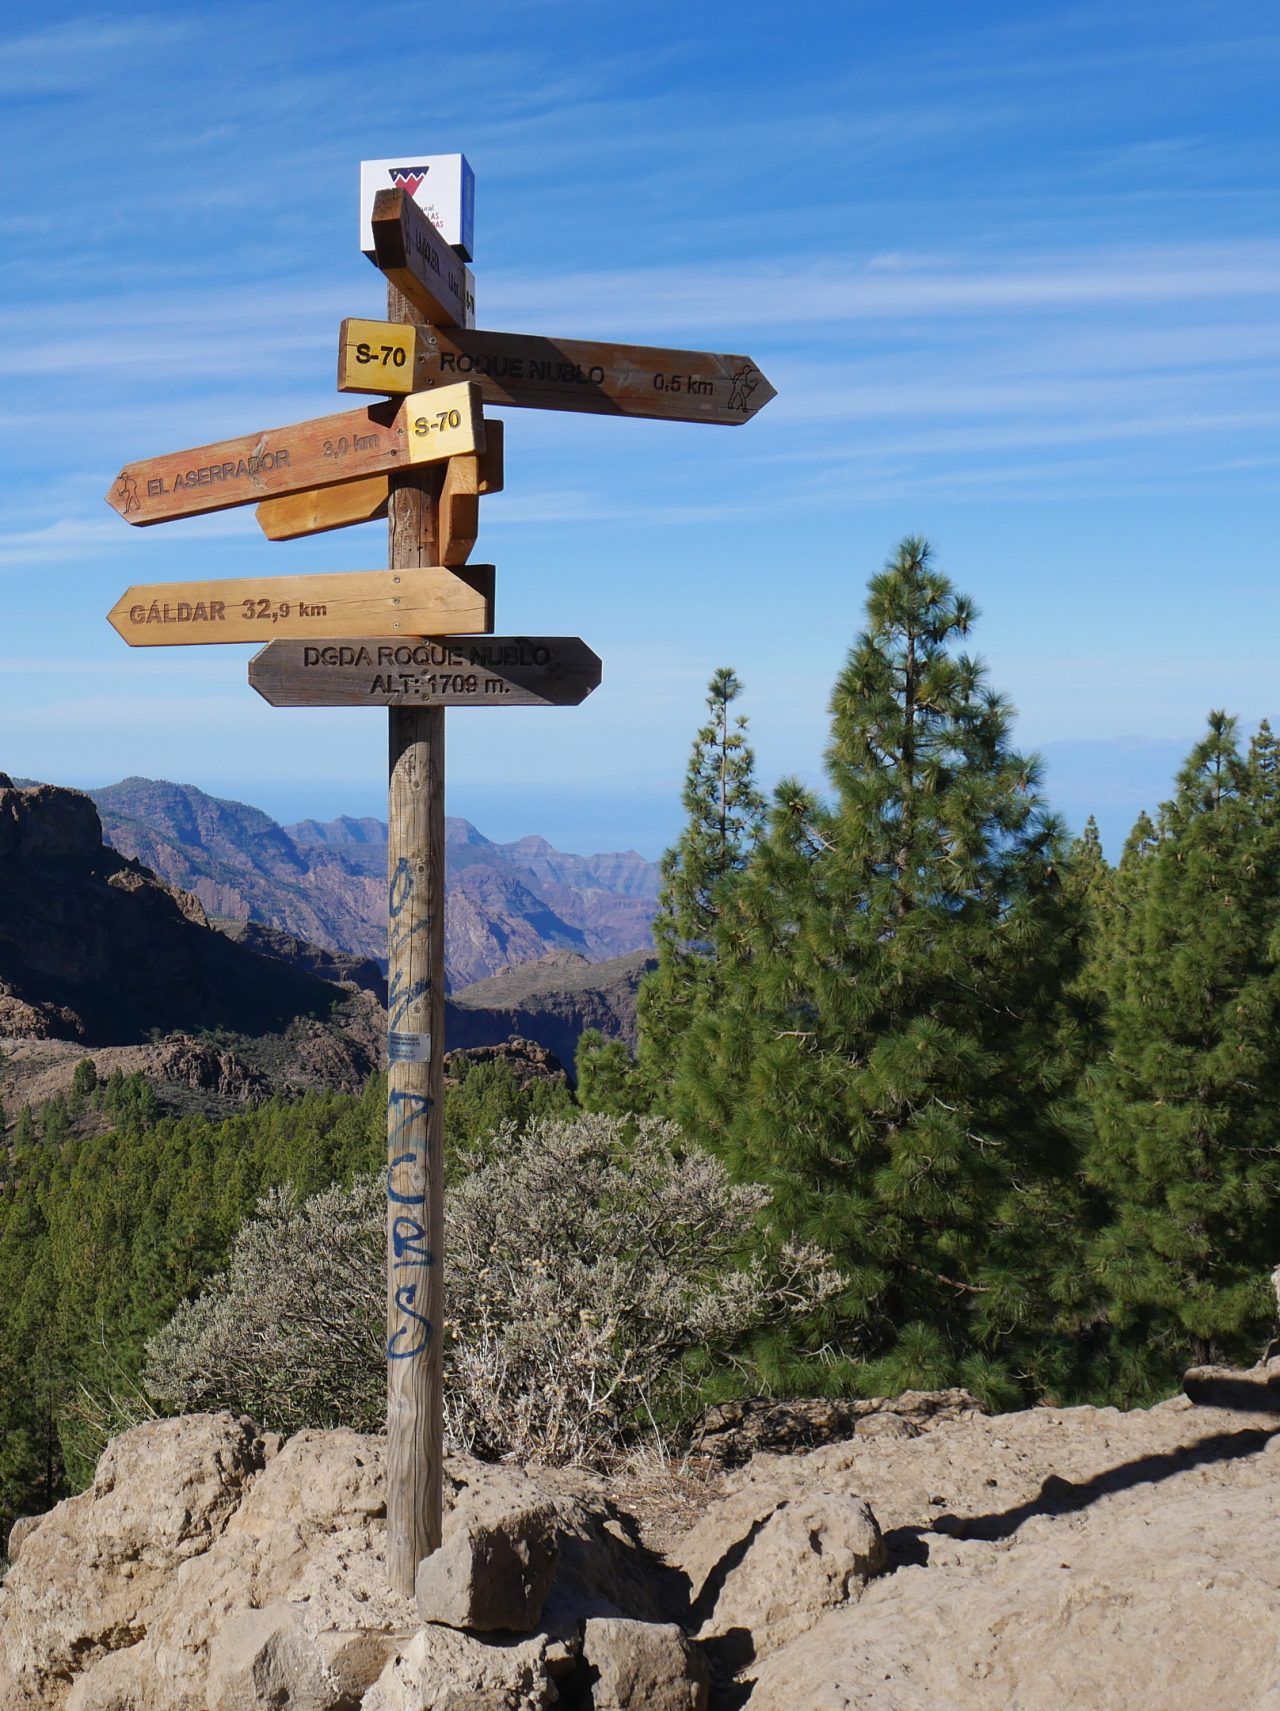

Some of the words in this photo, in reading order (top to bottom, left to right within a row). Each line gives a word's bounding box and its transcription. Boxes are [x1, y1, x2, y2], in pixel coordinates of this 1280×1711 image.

[355, 343, 406, 368] S-70
[439, 352, 523, 379] ROQUE
[528, 360, 605, 386] NUBLO
[653, 373, 681, 393] 0,5
[687, 376, 714, 396] km
[414, 409, 462, 437] S-70
[147, 478, 168, 498] EL
[173, 449, 291, 493] ASERRADOR
[323, 439, 347, 460] 3,0
[352, 432, 379, 453] km
[129, 600, 226, 624] GÁLDAR
[242, 598, 290, 623] 32,9
[299, 602, 327, 617] km
[303, 646, 372, 667] DGDA
[377, 646, 463, 667] ROQUE
[370, 674, 419, 694] ALT:
[428, 674, 478, 694] 1709
[484, 677, 511, 694] m.
